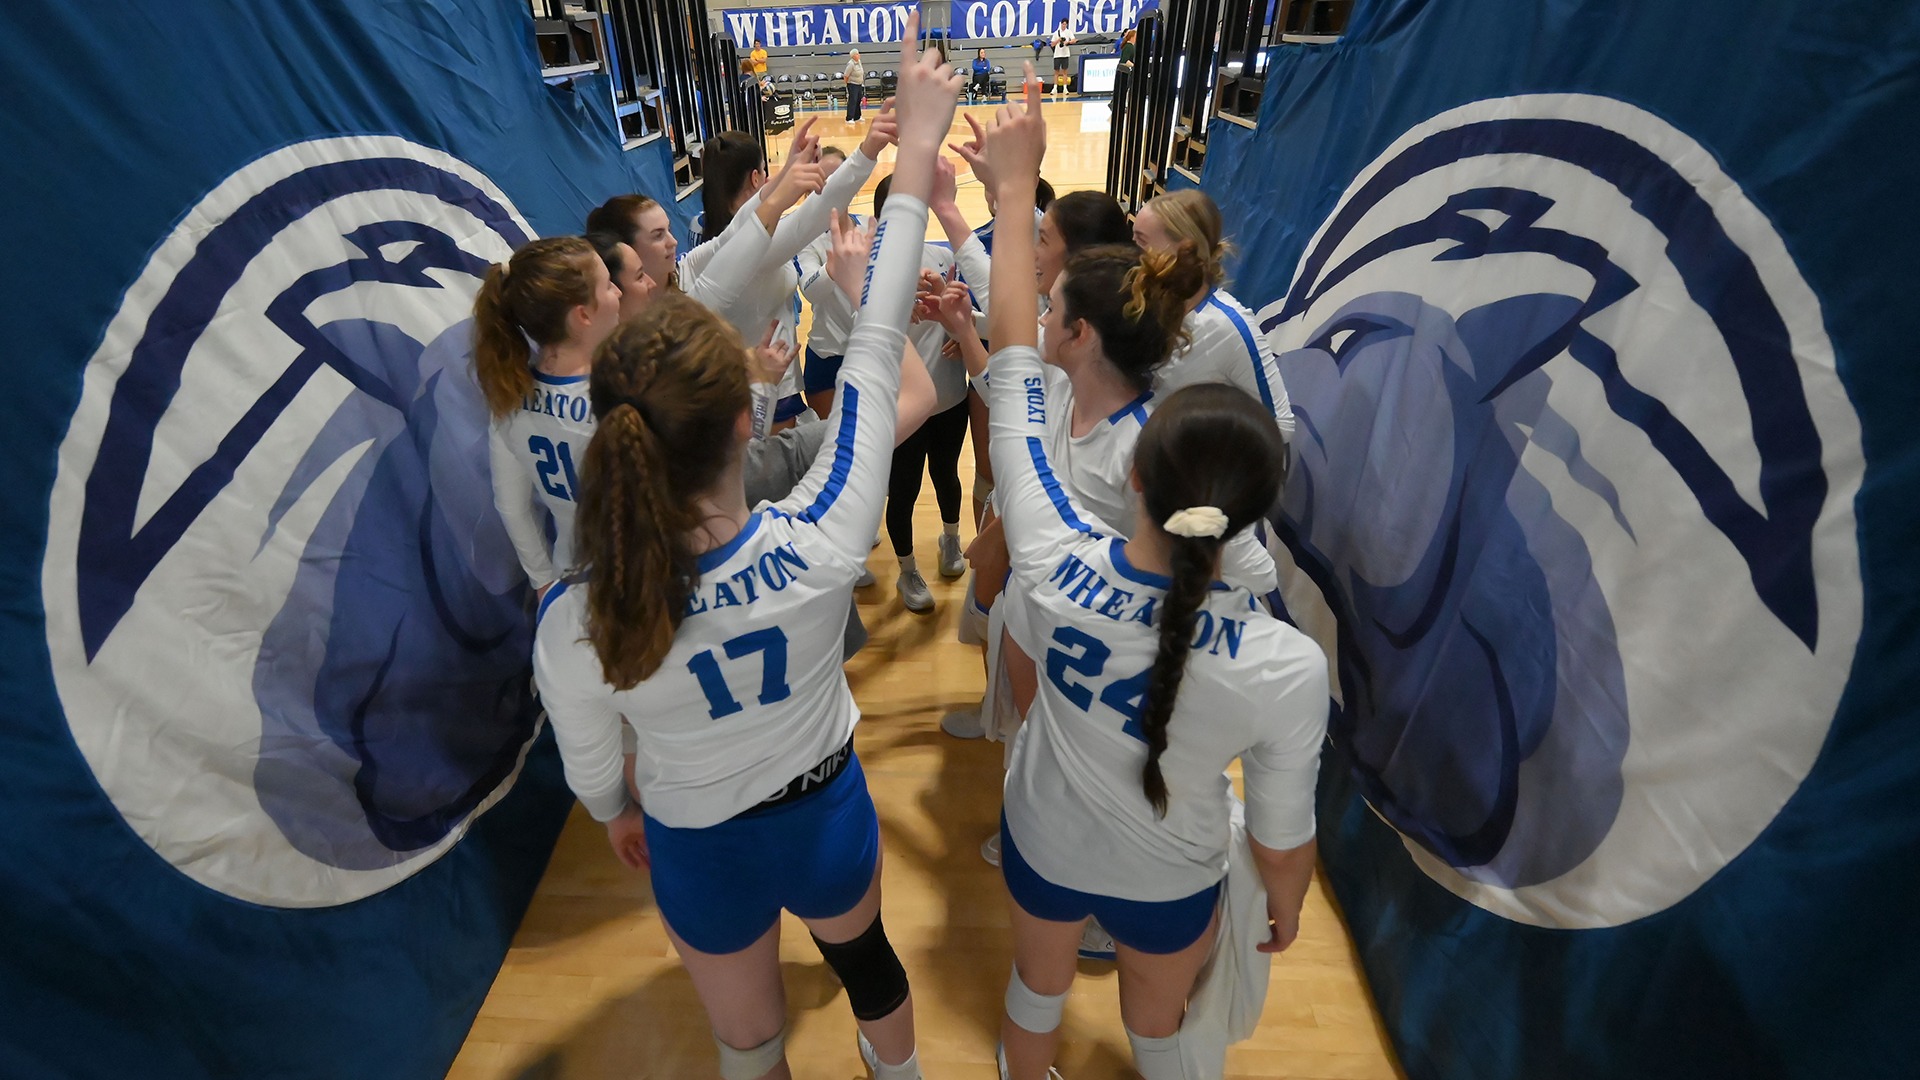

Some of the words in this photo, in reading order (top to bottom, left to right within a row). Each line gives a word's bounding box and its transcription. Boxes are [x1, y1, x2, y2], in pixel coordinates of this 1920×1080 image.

[966, 0, 1144, 39] COLLEGE
[1086, 68, 1116, 78] WHEATO
[521, 387, 593, 424] EATO
[1024, 377, 1046, 425] LYONS
[528, 435, 580, 503] 21
[684, 541, 809, 618] EATON
[1049, 554, 1247, 660] WHEAON
[686, 626, 791, 720] 17
[1046, 626, 1153, 745] 24
[801, 746, 849, 791] NIK
